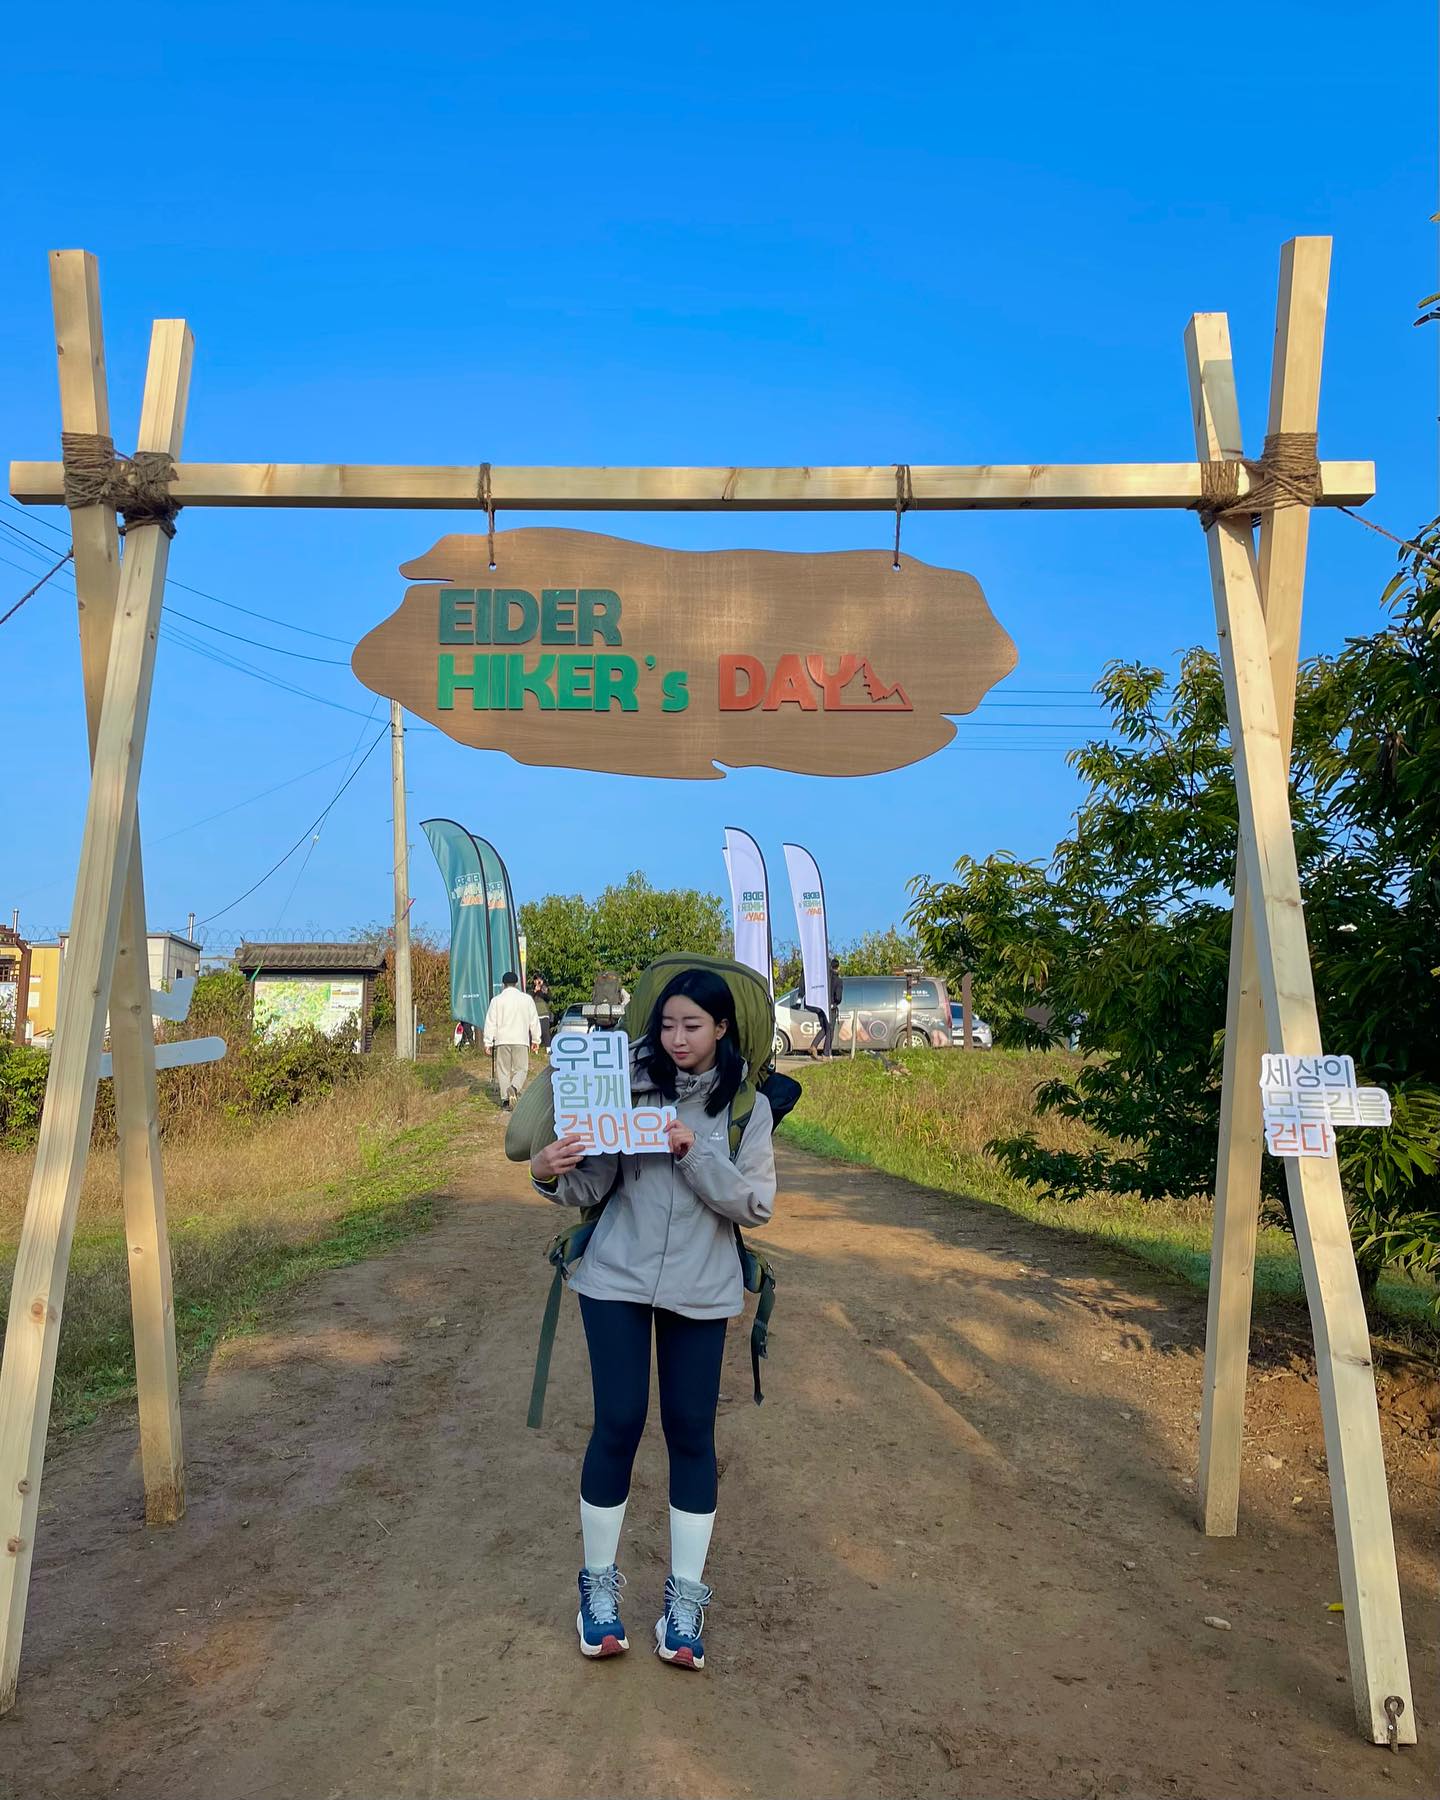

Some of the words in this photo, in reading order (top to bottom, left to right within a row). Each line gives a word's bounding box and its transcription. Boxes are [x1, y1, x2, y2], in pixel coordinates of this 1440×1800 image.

[439, 588, 622, 646] EIDER
[437, 653, 690, 713] HIKER's
[718, 654, 864, 712] DAY
[557, 1036, 623, 1071] 우리
[1266, 1058, 1352, 1088] 세상의
[558, 1073, 626, 1109] 함께
[1270, 1123, 1331, 1153] 걷다
